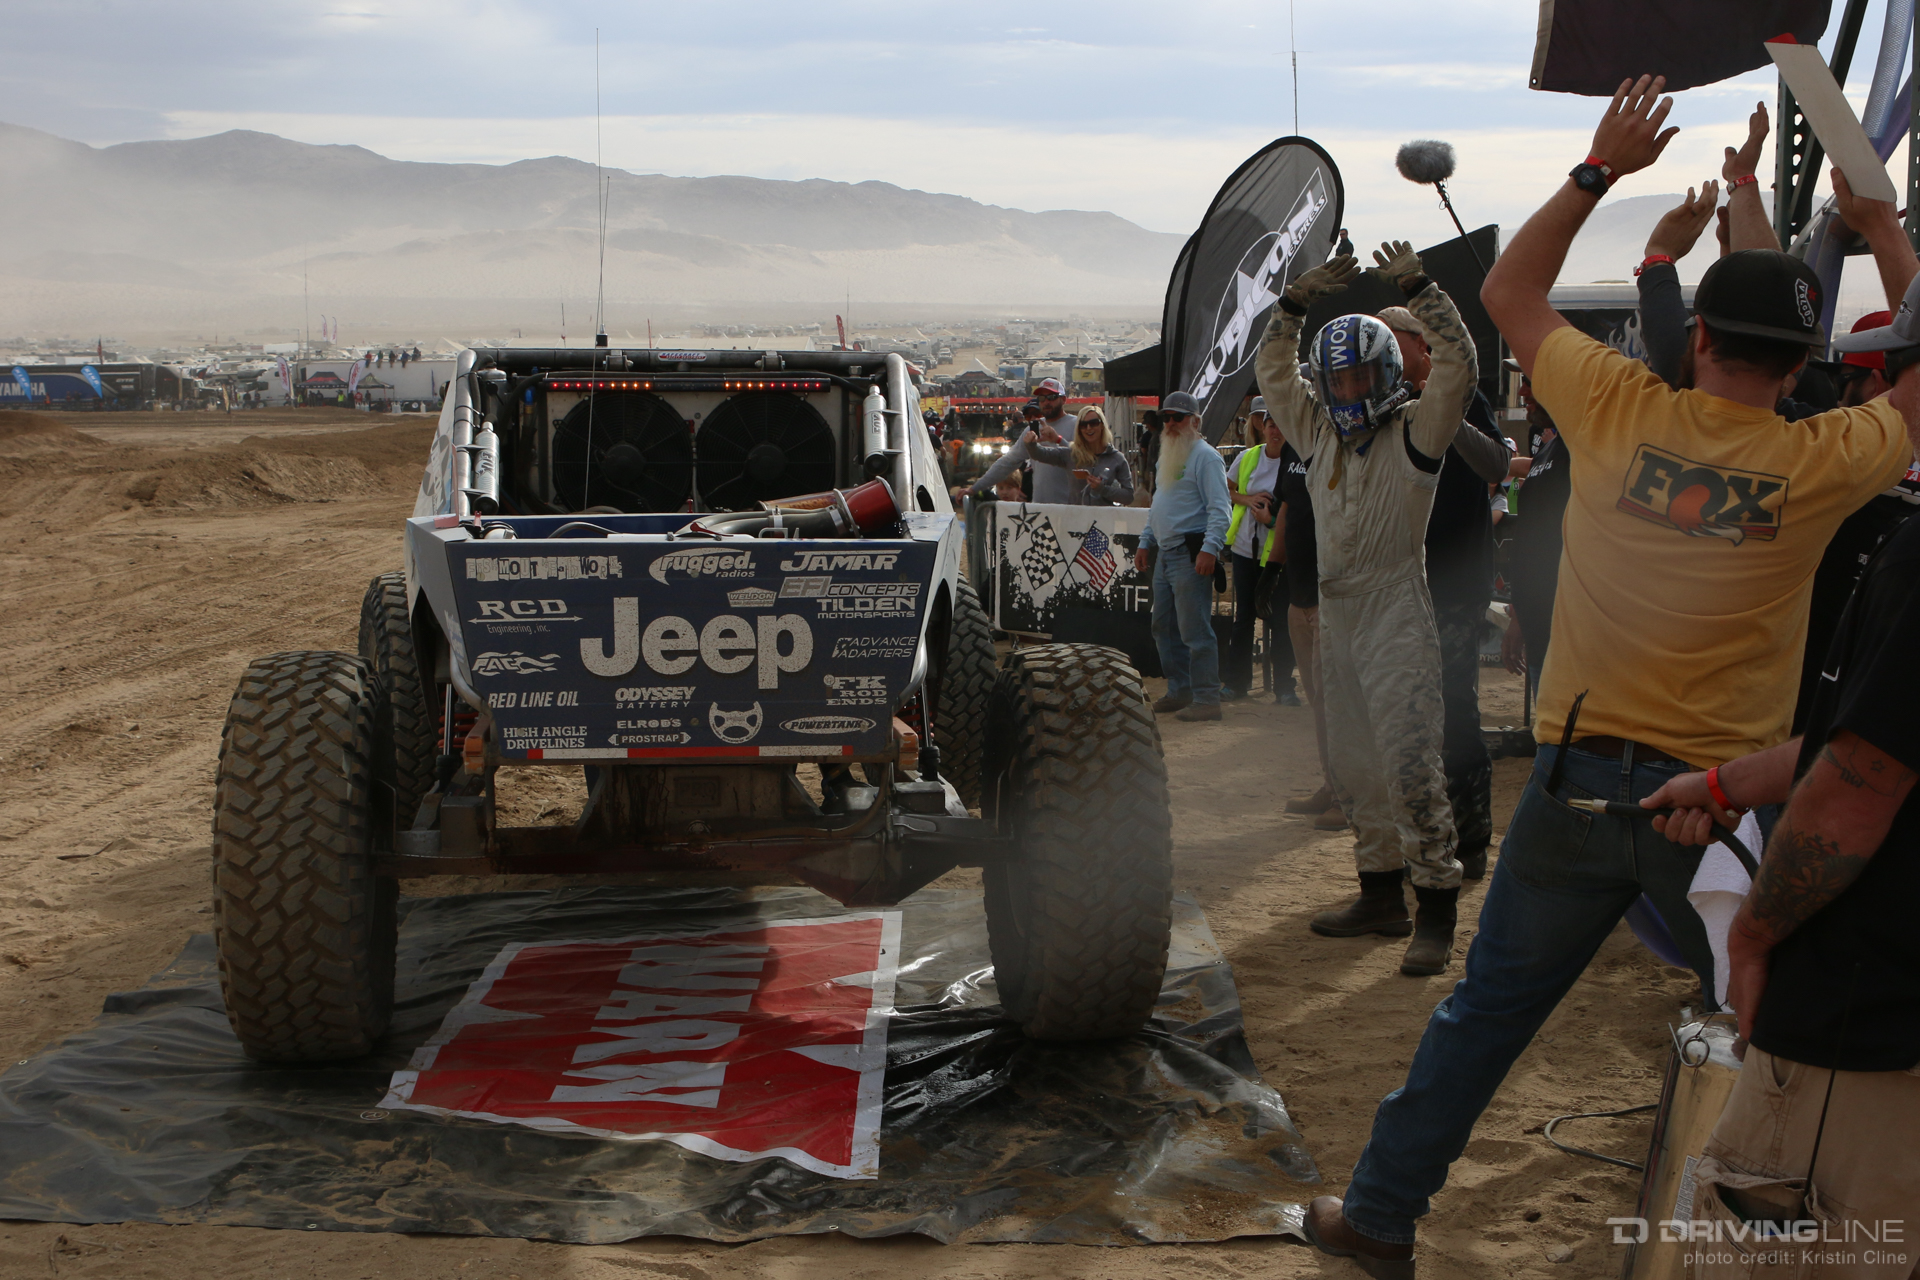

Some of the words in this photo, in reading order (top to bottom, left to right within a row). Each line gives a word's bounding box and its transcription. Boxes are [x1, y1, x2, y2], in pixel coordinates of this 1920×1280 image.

[1287, 195, 1325, 257] EXPRESS
[1192, 189, 1314, 400] RUBICON
[1629, 450, 1783, 524] FOX
[780, 550, 902, 571] JAMAR
[716, 570, 755, 578] radios
[784, 577, 830, 597] EFI
[827, 585, 919, 595] CONCEPTS
[817, 597, 915, 611] TILDEN
[1120, 585, 1154, 613] TF
[477, 600, 568, 616] RCD
[818, 611, 915, 619] MOTORSPORTS
[580, 597, 814, 690] Jeep
[849, 636, 917, 647] ADVANCE
[837, 648, 913, 658] ADAPTERS
[832, 676, 886, 689] FK
[488, 692, 517, 708] RED
[520, 691, 552, 707] LINE
[557, 691, 579, 707] OIL
[615, 686, 696, 701] ODYSSEY
[616, 701, 690, 709] BATTERY
[503, 727, 538, 738] HIGH
[542, 726, 587, 737] ANGLE
[791, 719, 864, 731] POWERTANK
[506, 737, 585, 749] DRIVELINES
[621, 734, 679, 743] PROSTRAP
[549, 944, 770, 1109] WARN
